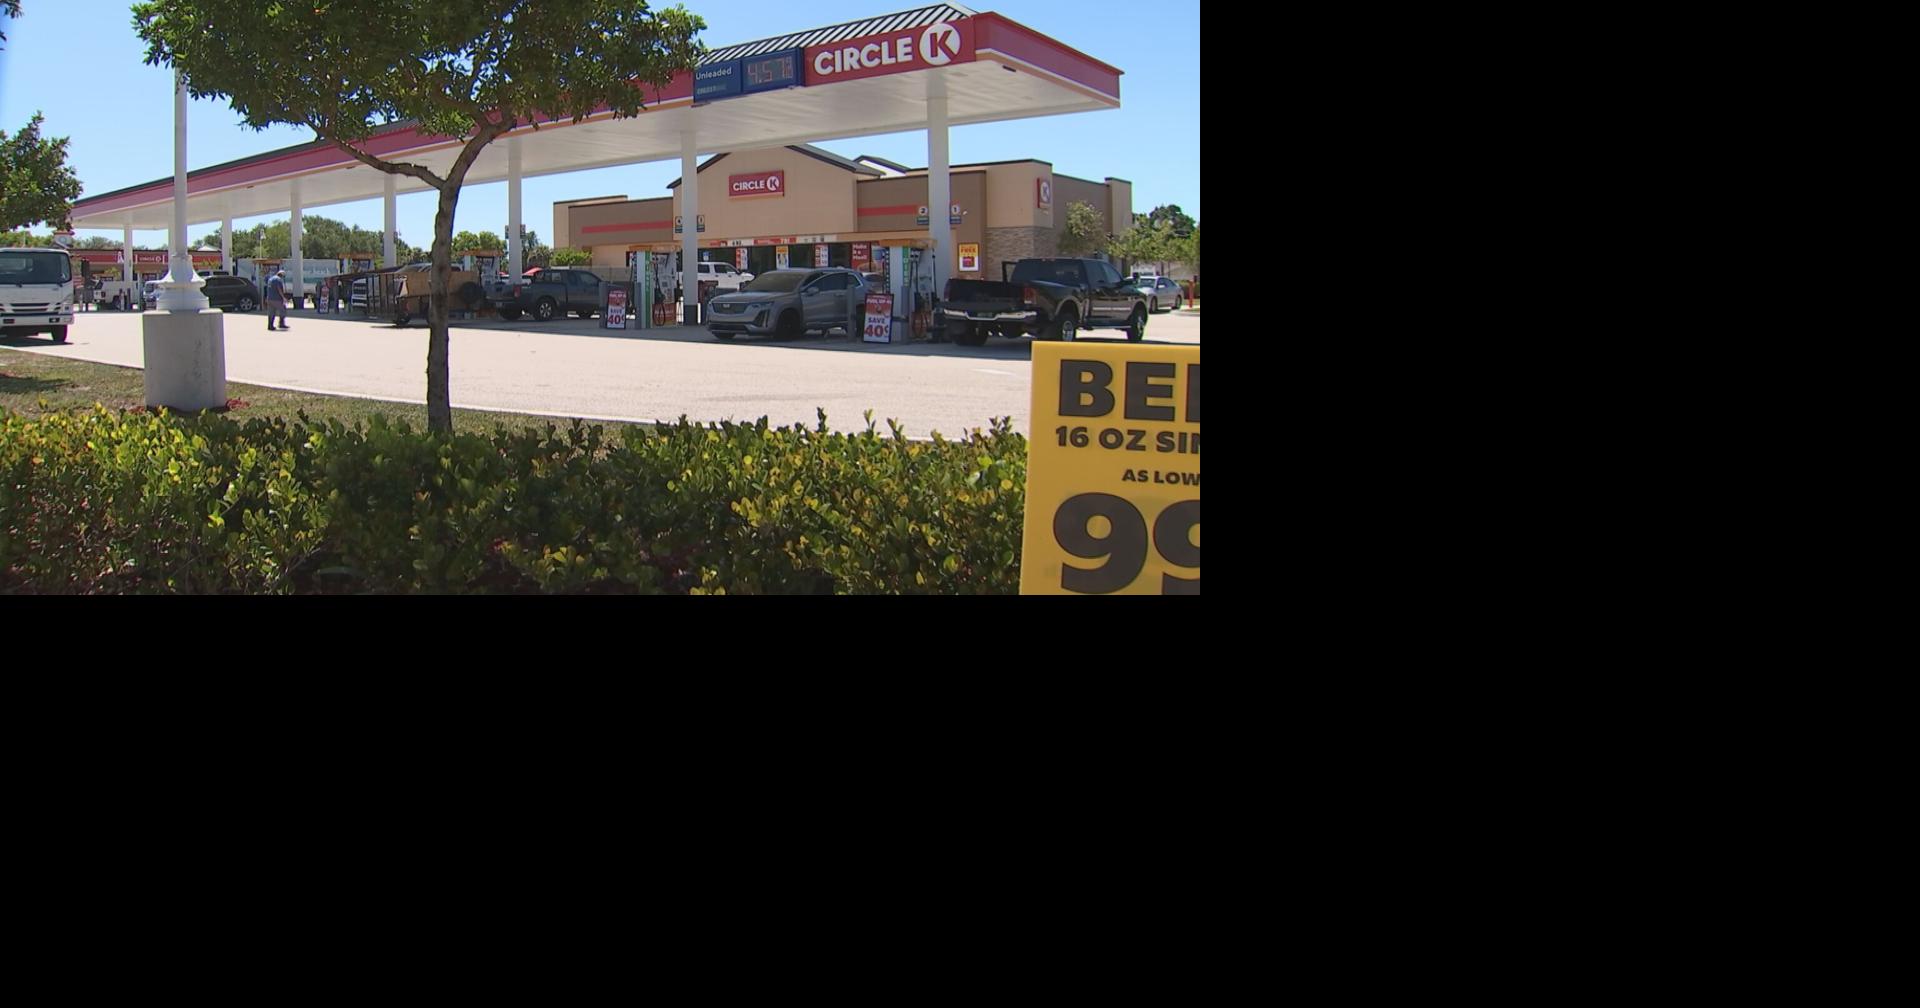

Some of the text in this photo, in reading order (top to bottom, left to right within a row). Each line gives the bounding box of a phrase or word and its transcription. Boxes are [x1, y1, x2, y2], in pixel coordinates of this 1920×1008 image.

[813, 36, 913, 76] CIRCLE
[923, 24, 960, 64] K
[695, 66, 732, 80] Unleaded
[732, 176, 780, 192] CIRCLE K
[1056, 425, 1090, 448] 16
[1098, 428, 1146, 451] OZ
[1121, 469, 1200, 486] AS LOW
